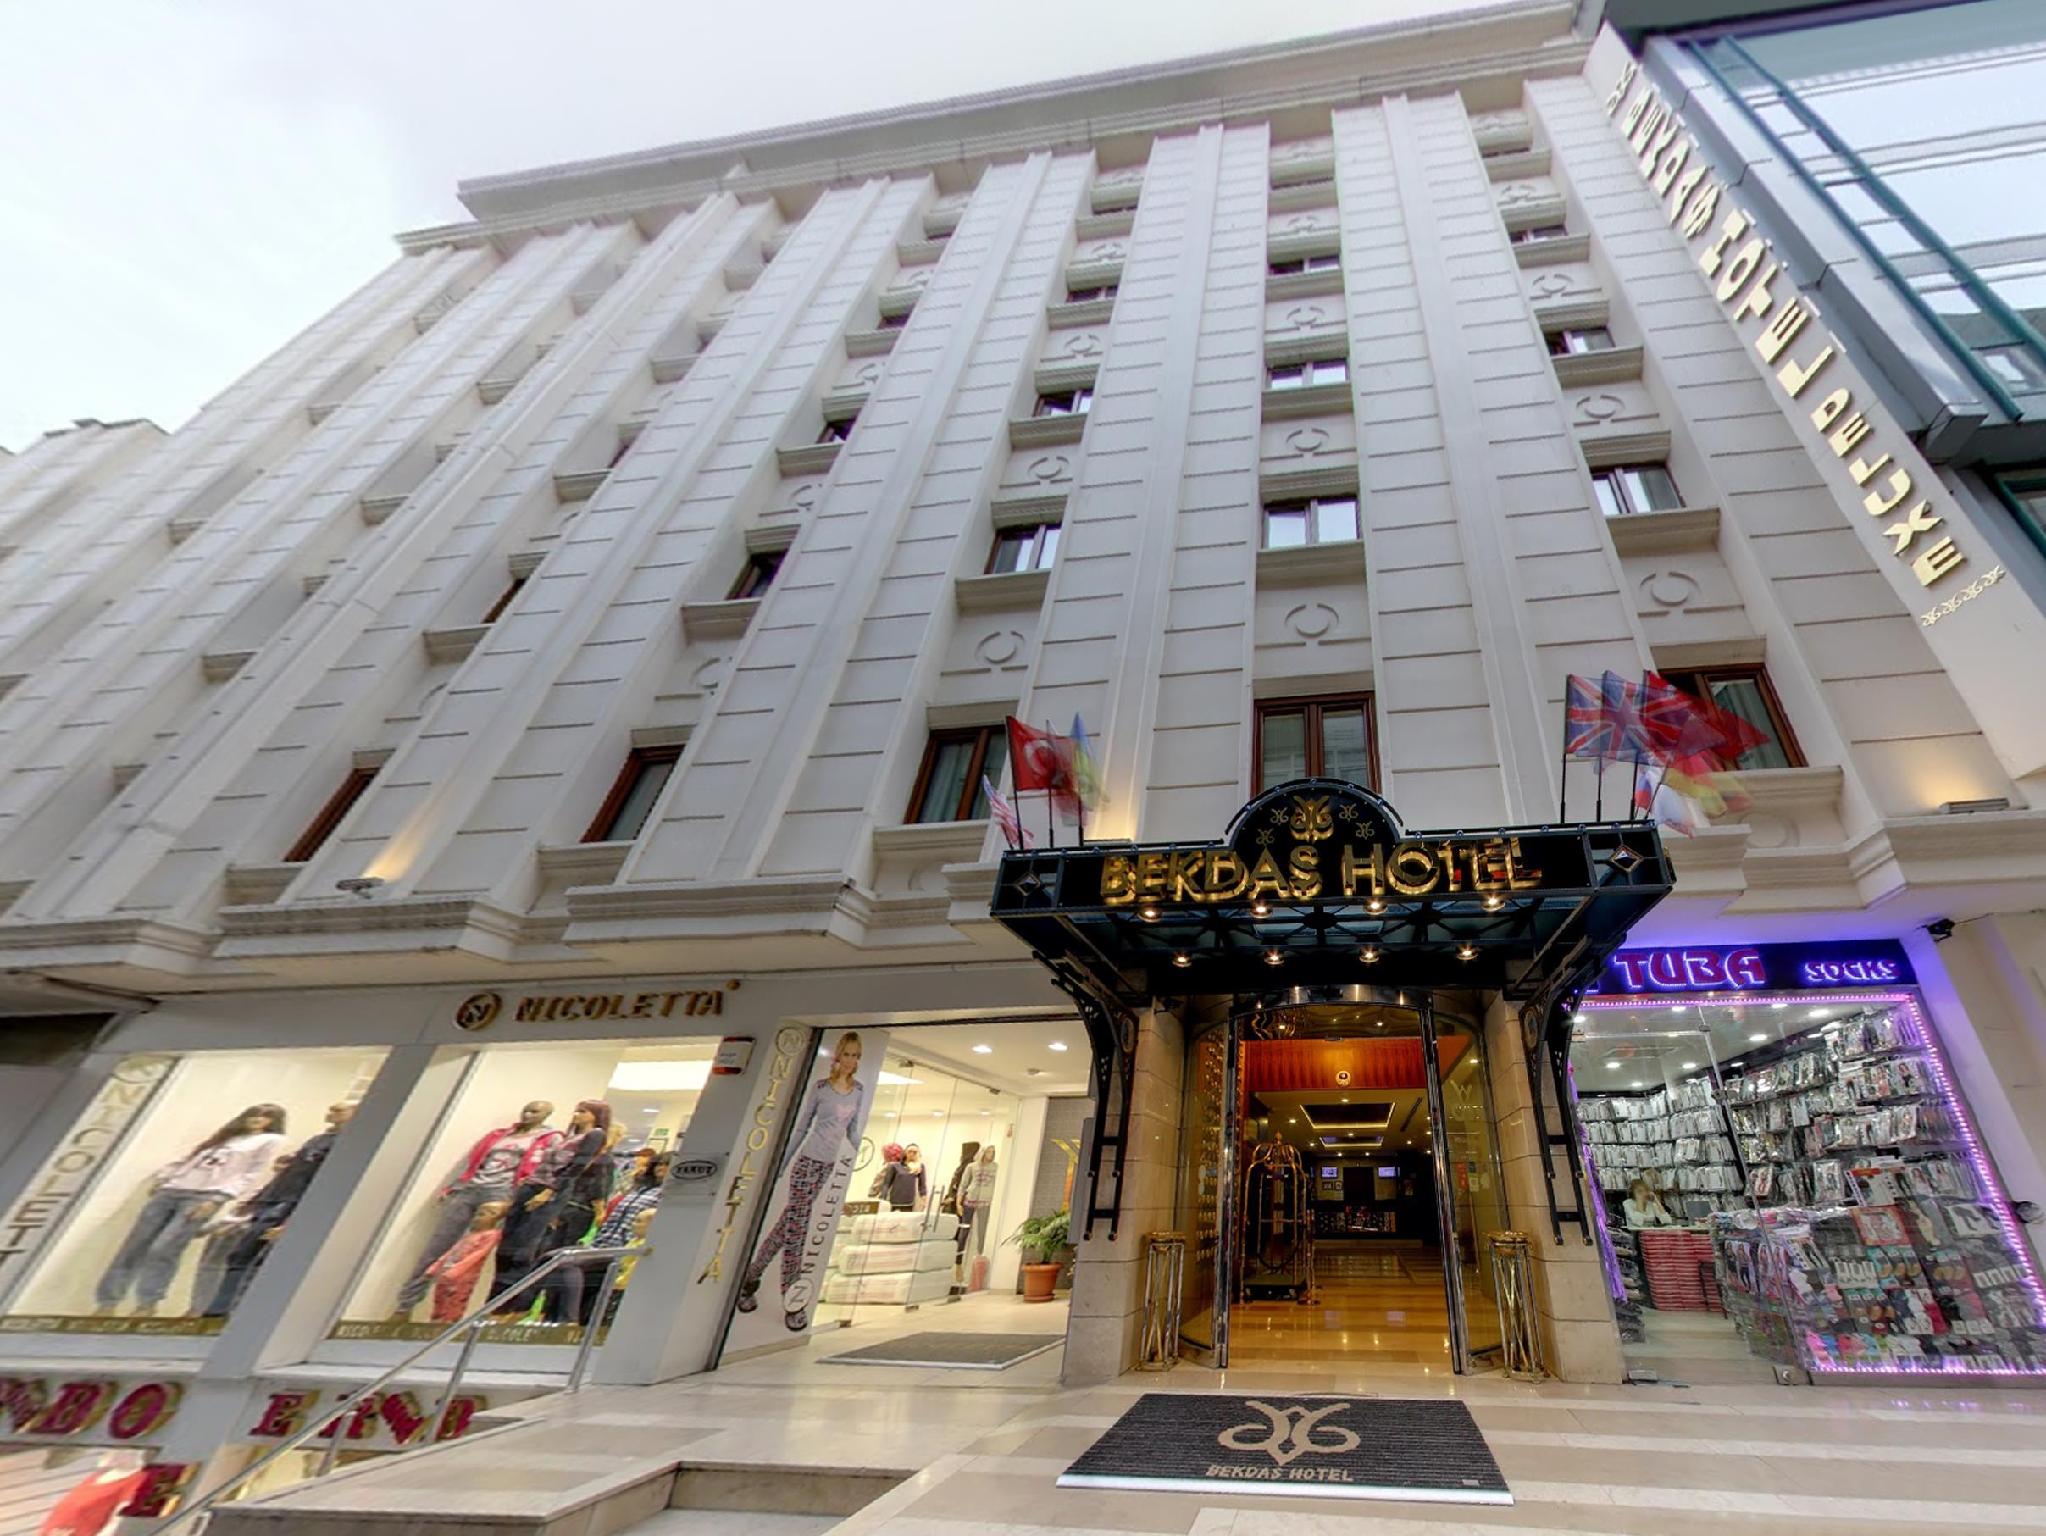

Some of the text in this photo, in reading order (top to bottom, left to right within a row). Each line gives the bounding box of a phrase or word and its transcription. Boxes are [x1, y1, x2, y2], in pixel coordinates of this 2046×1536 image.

[1699, 208, 1837, 399] HOTEL
[1811, 388, 1967, 587] DELUXE
[1100, 836, 1540, 904] BEKDAS HOTEL
[1614, 948, 1899, 990] TUBA SOCKS
[514, 990, 725, 1023] NICOLETTA
[800, 1156, 852, 1275] NICOLETTA
[1288, 1467, 1354, 1482] HOTEL
